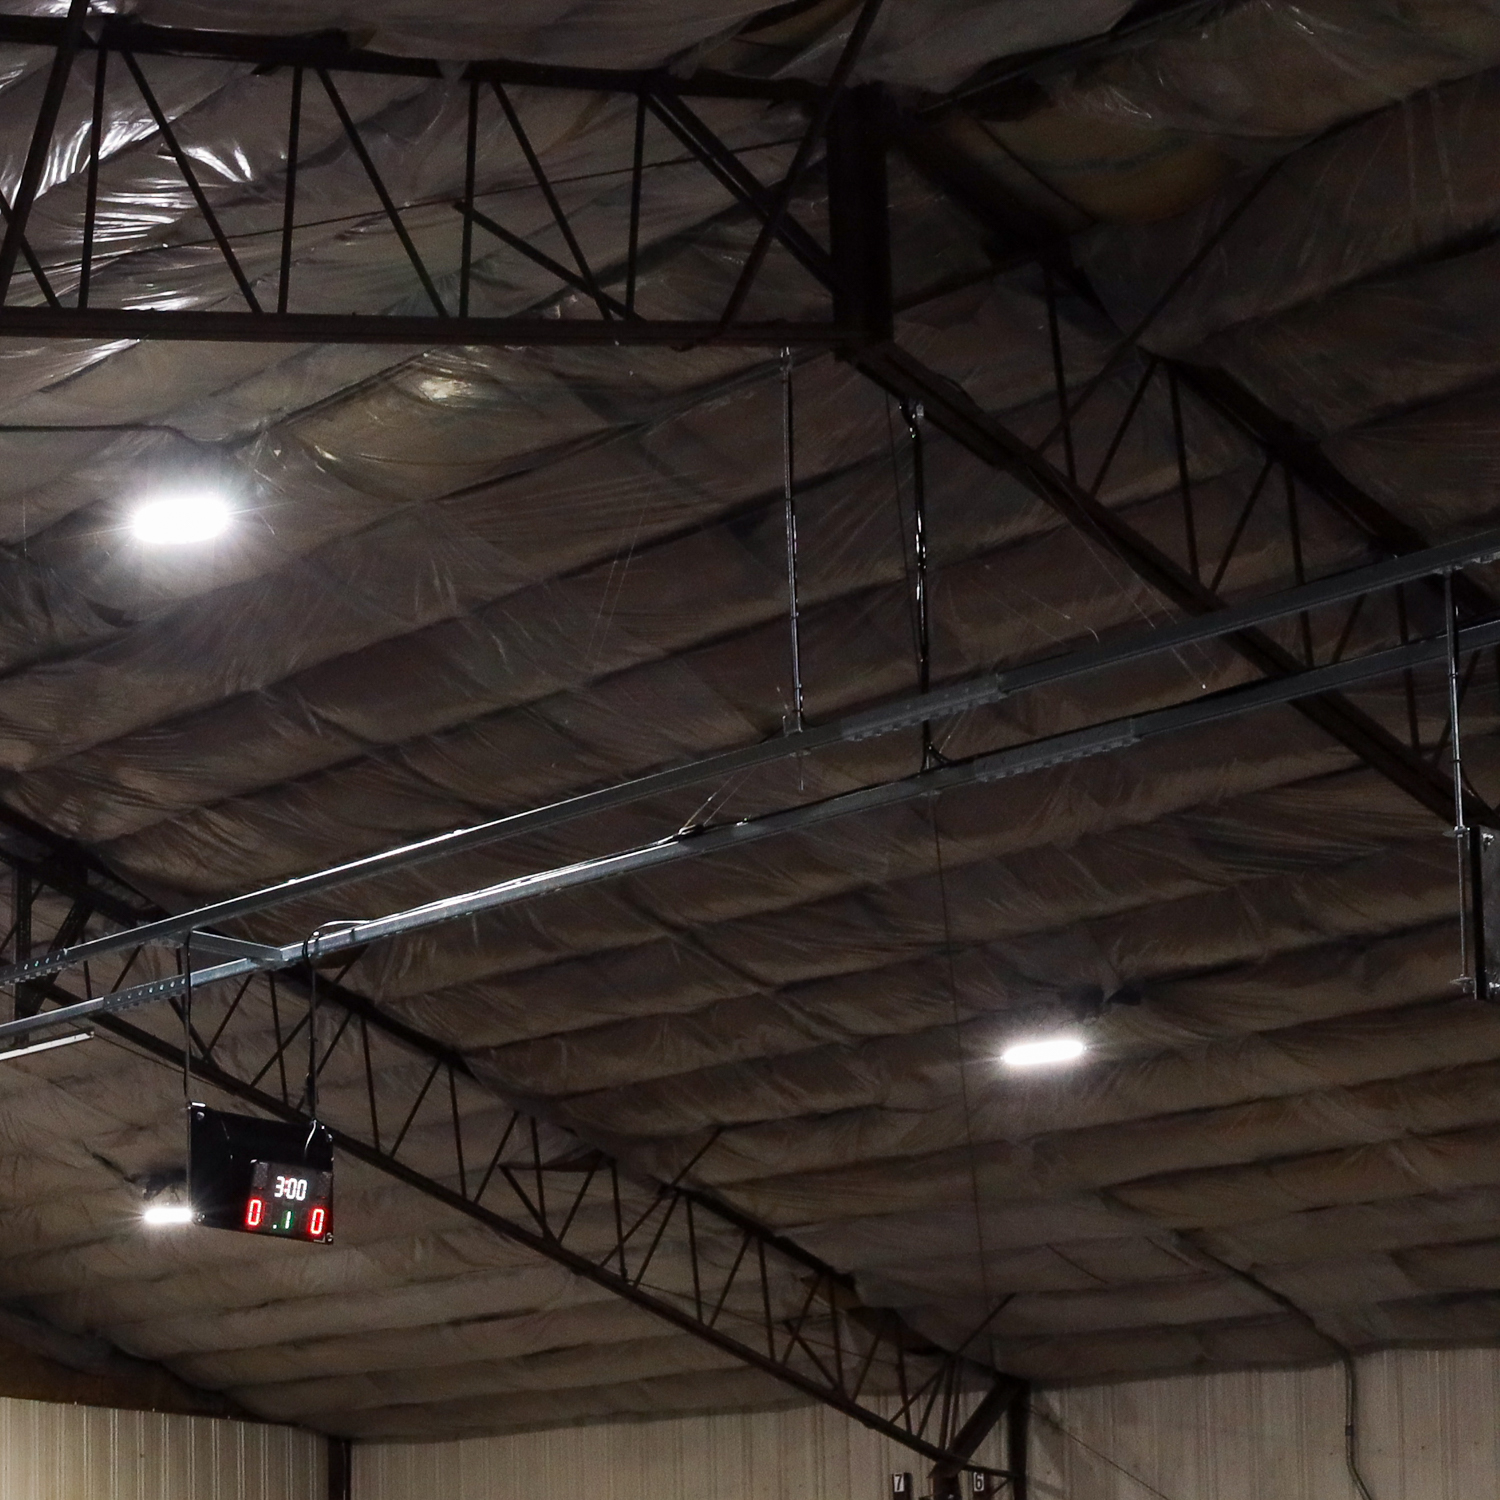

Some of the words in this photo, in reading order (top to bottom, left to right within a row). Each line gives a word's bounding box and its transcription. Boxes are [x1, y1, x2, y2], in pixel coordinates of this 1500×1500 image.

[274, 1175, 308, 1201] 3:00
[247, 1199, 262, 1226] 0
[310, 1208, 325, 1235] 0
[895, 1473, 903, 1491] 7
[974, 1473, 983, 1490] 6
